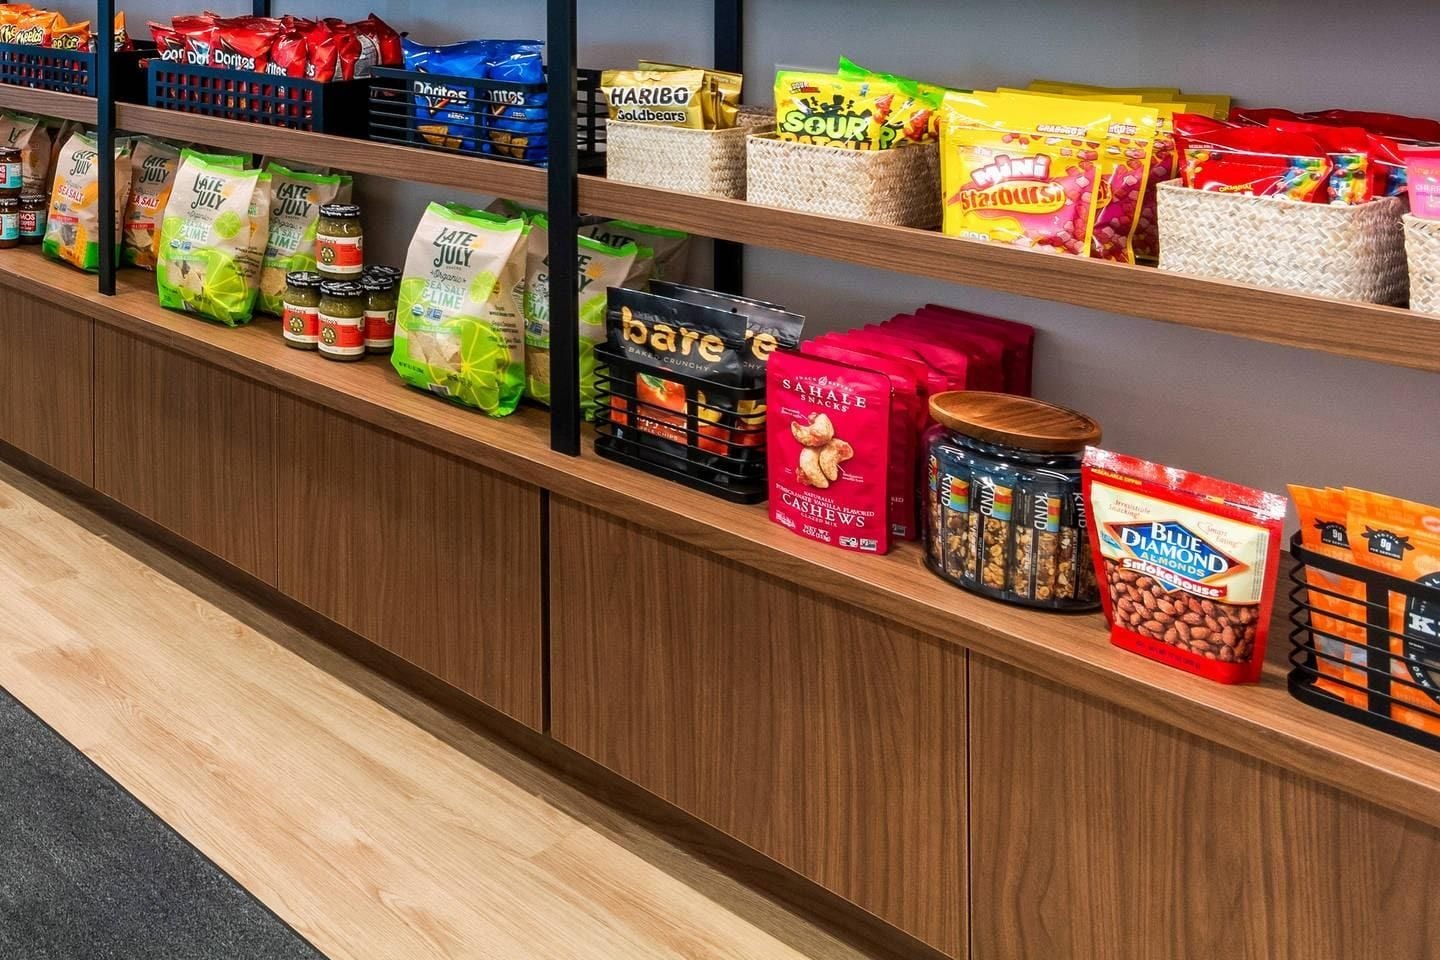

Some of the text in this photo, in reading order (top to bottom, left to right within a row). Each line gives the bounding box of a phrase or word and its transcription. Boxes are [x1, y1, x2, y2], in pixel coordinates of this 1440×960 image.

[215, 49, 256, 70] Doritos
[266, 61, 287, 78] ritos
[414, 80, 468, 104] Doritos
[612, 87, 689, 106] HARIBO
[617, 110, 687, 123] Goldbears
[783, 109, 868, 142] SOUR
[69, 161, 92, 176] JULY
[143, 154, 171, 170] LATE
[138, 169, 170, 184] JULY
[192, 172, 224, 194] LATE
[68, 189, 84, 202] SALT
[140, 196, 160, 208] SALT
[190, 193, 227, 211] JULY
[276, 182, 313, 201] LATE
[961, 184, 1064, 211] Starburst
[272, 198, 313, 217] JULY
[432, 226, 478, 248] LATE
[433, 244, 474, 269] JULY
[445, 283, 466, 294] SALT
[431, 293, 464, 310] LIME
[621, 306, 726, 363] bare
[663, 356, 710, 373] CRUNCHY
[782, 378, 867, 409] SAHALE
[800, 394, 850, 413] SNACKS
[940, 473, 954, 508] KIND
[979, 475, 996, 517] KIND
[782, 493, 865, 528] CASHEWS
[813, 497, 842, 512] VANILLA
[843, 507, 875, 517] FLAVORED
[1033, 492, 1049, 531] KIND
[1072, 491, 1088, 529] KIND
[1151, 521, 1202, 555] BLUE
[1121, 527, 1229, 574] DIAMOND
[1140, 552, 1206, 579] ALMONDS
[1122, 558, 1221, 598] Smokehouse
